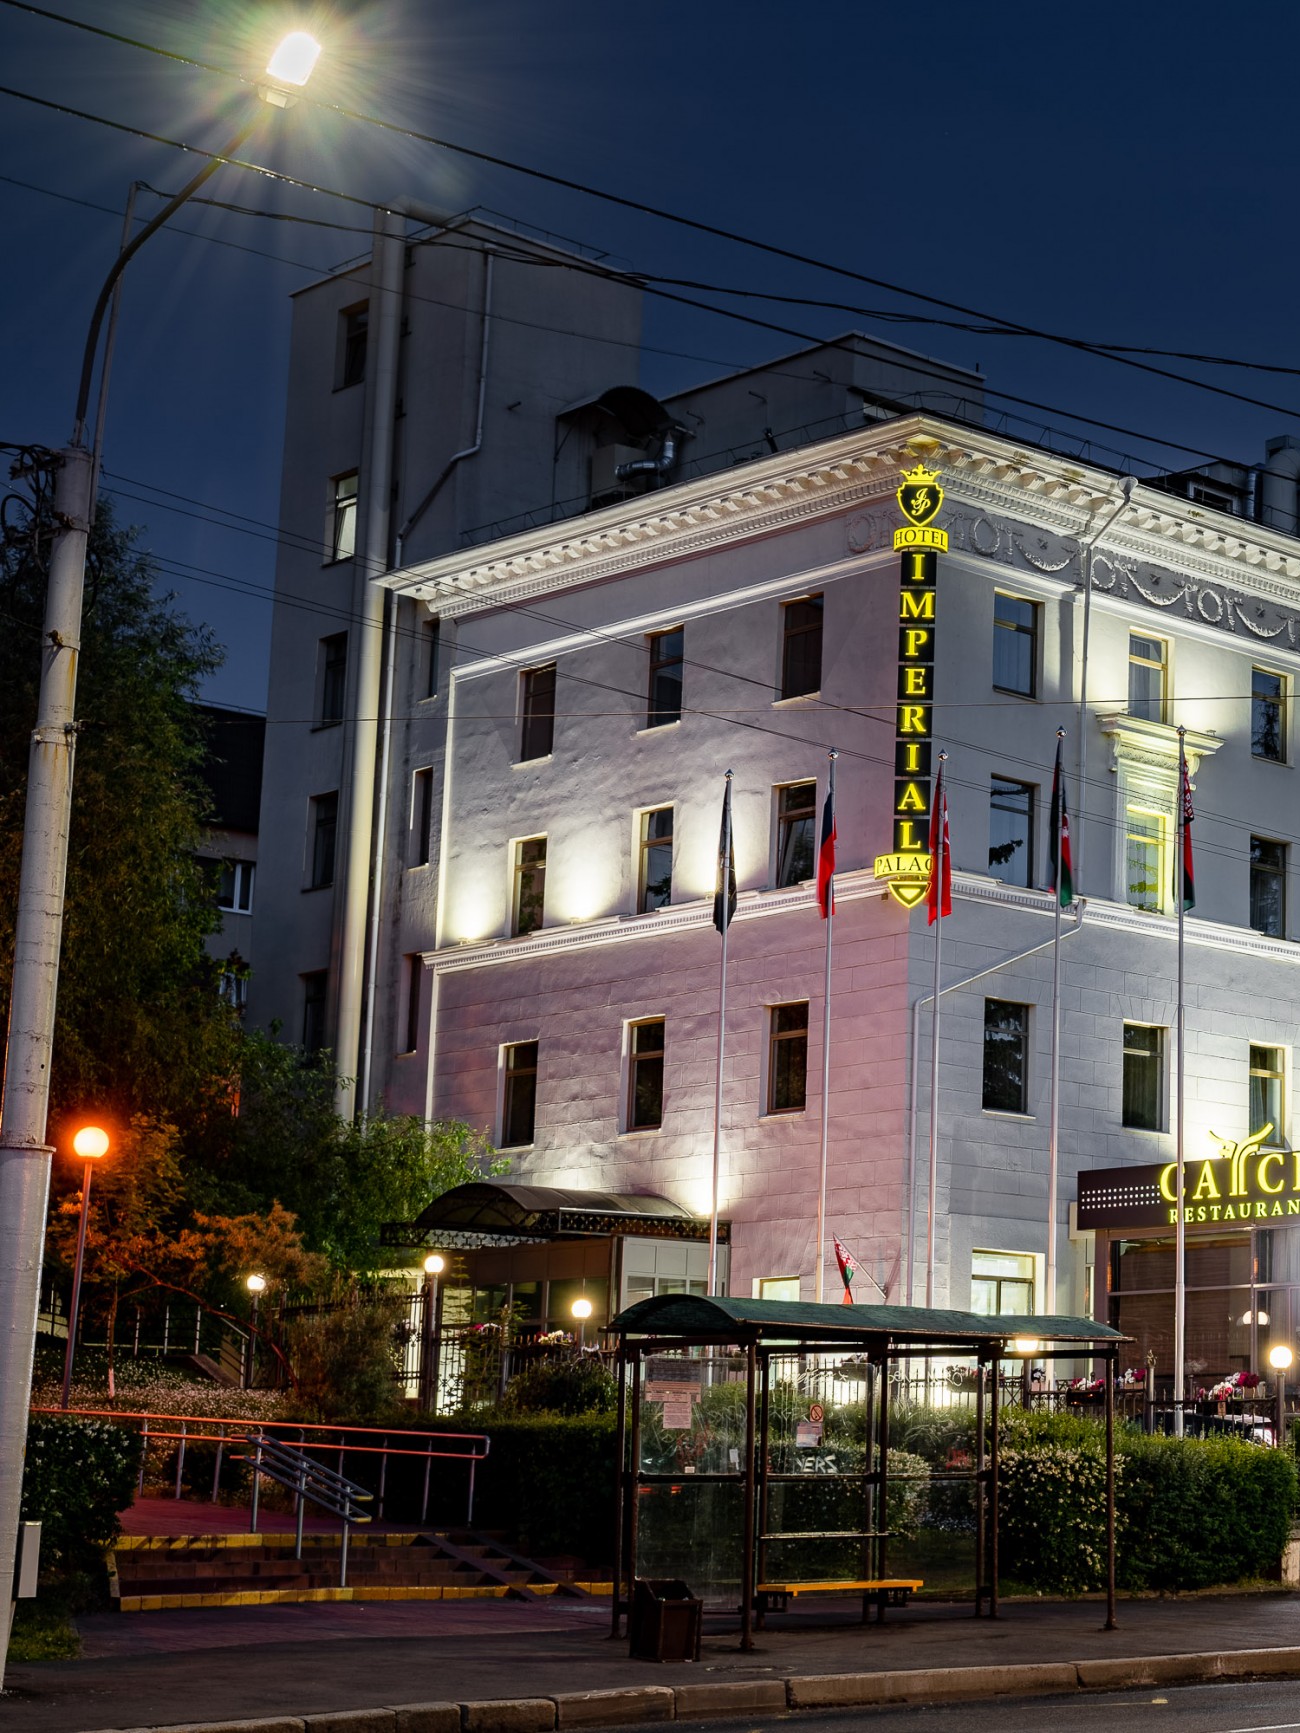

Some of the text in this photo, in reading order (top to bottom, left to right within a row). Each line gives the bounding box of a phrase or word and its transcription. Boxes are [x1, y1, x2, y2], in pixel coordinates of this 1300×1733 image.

[895, 529, 945, 547] HOTEL
[897, 554, 935, 849] IMPERIAL
[877, 856, 932, 873] PALAC
